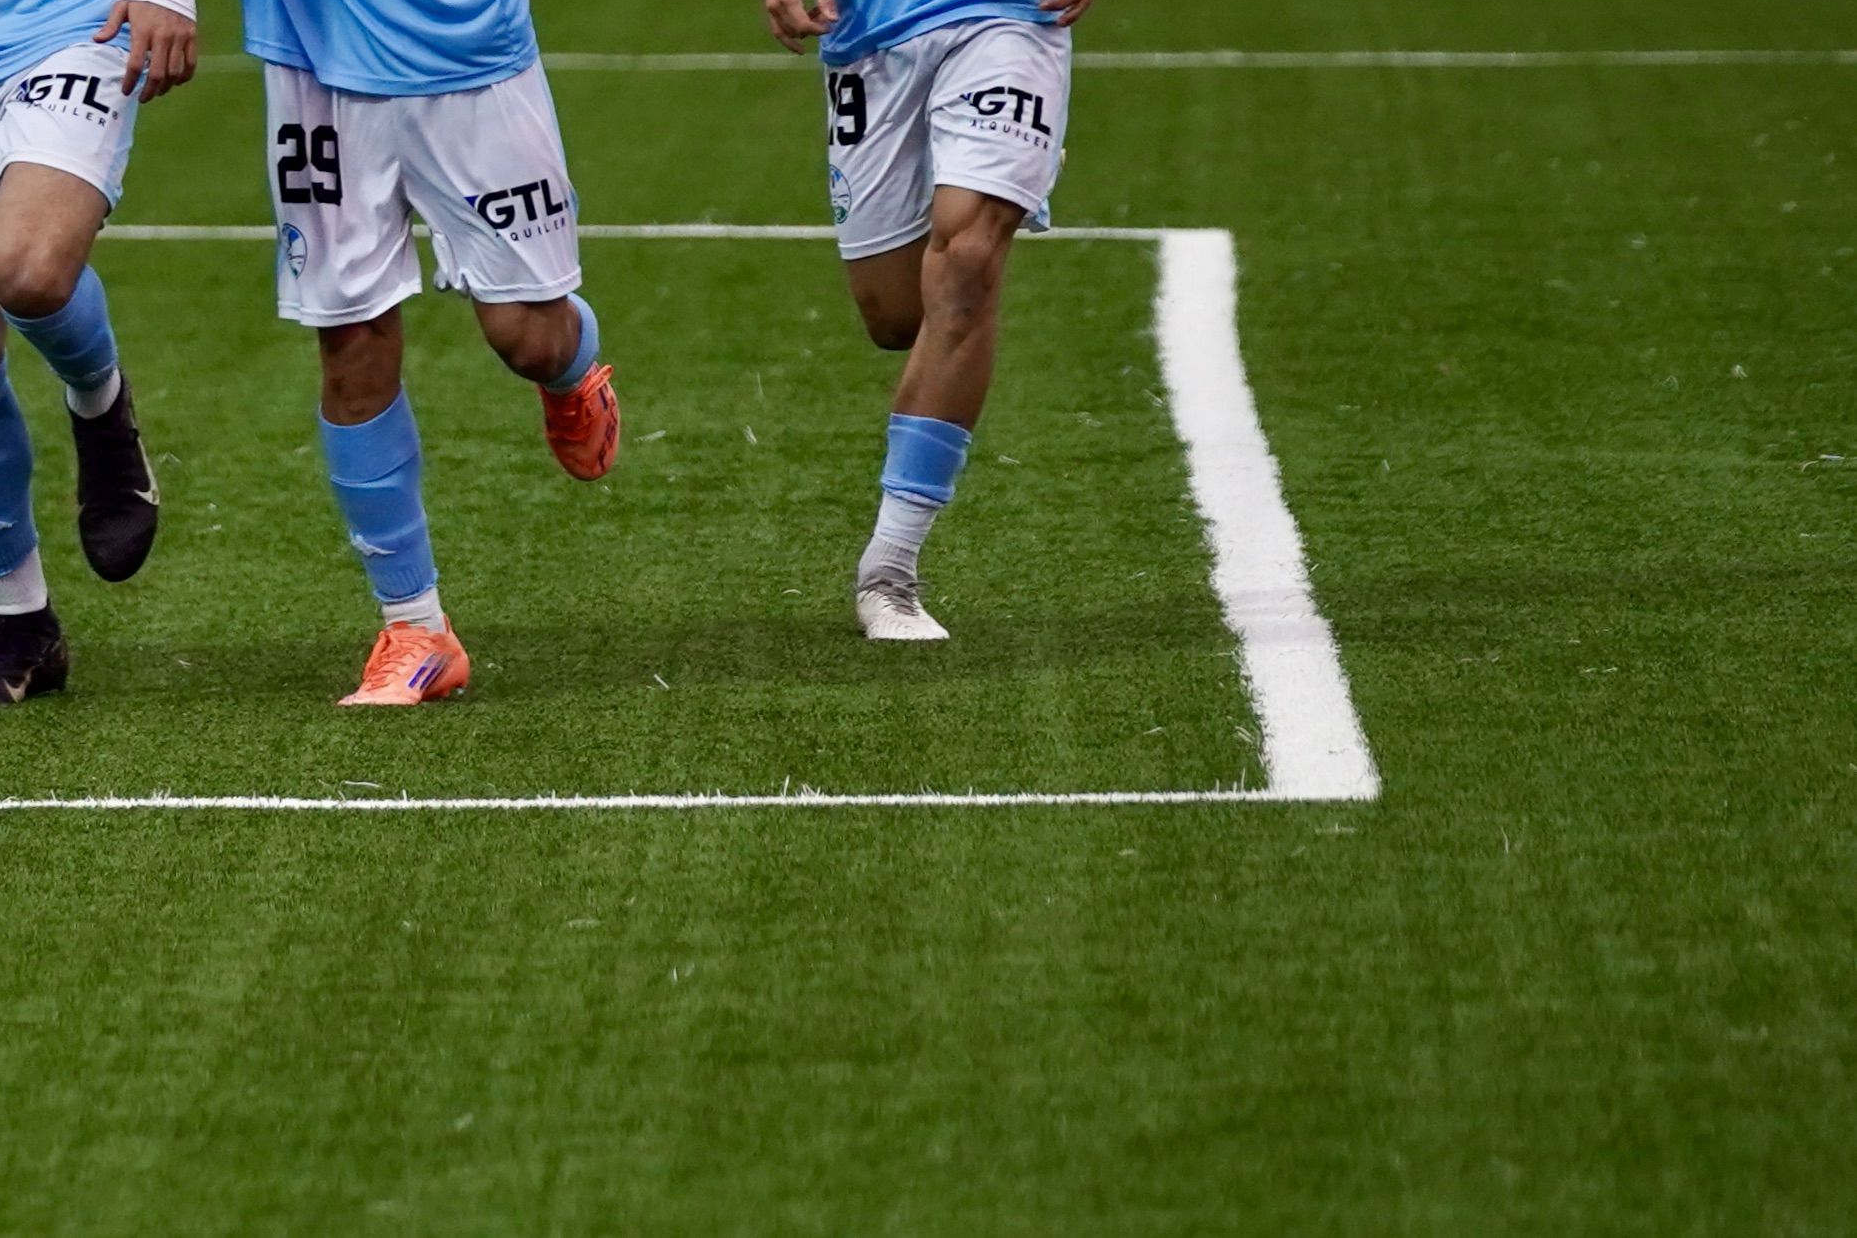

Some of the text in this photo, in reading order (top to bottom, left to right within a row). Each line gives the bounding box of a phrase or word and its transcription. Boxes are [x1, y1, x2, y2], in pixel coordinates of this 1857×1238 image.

[24, 73, 110, 114] GTL
[971, 86, 1051, 138] GTL
[969, 119, 1049, 151] ALQUILER
[277, 123, 343, 206] 29
[477, 178, 563, 229] GTL
